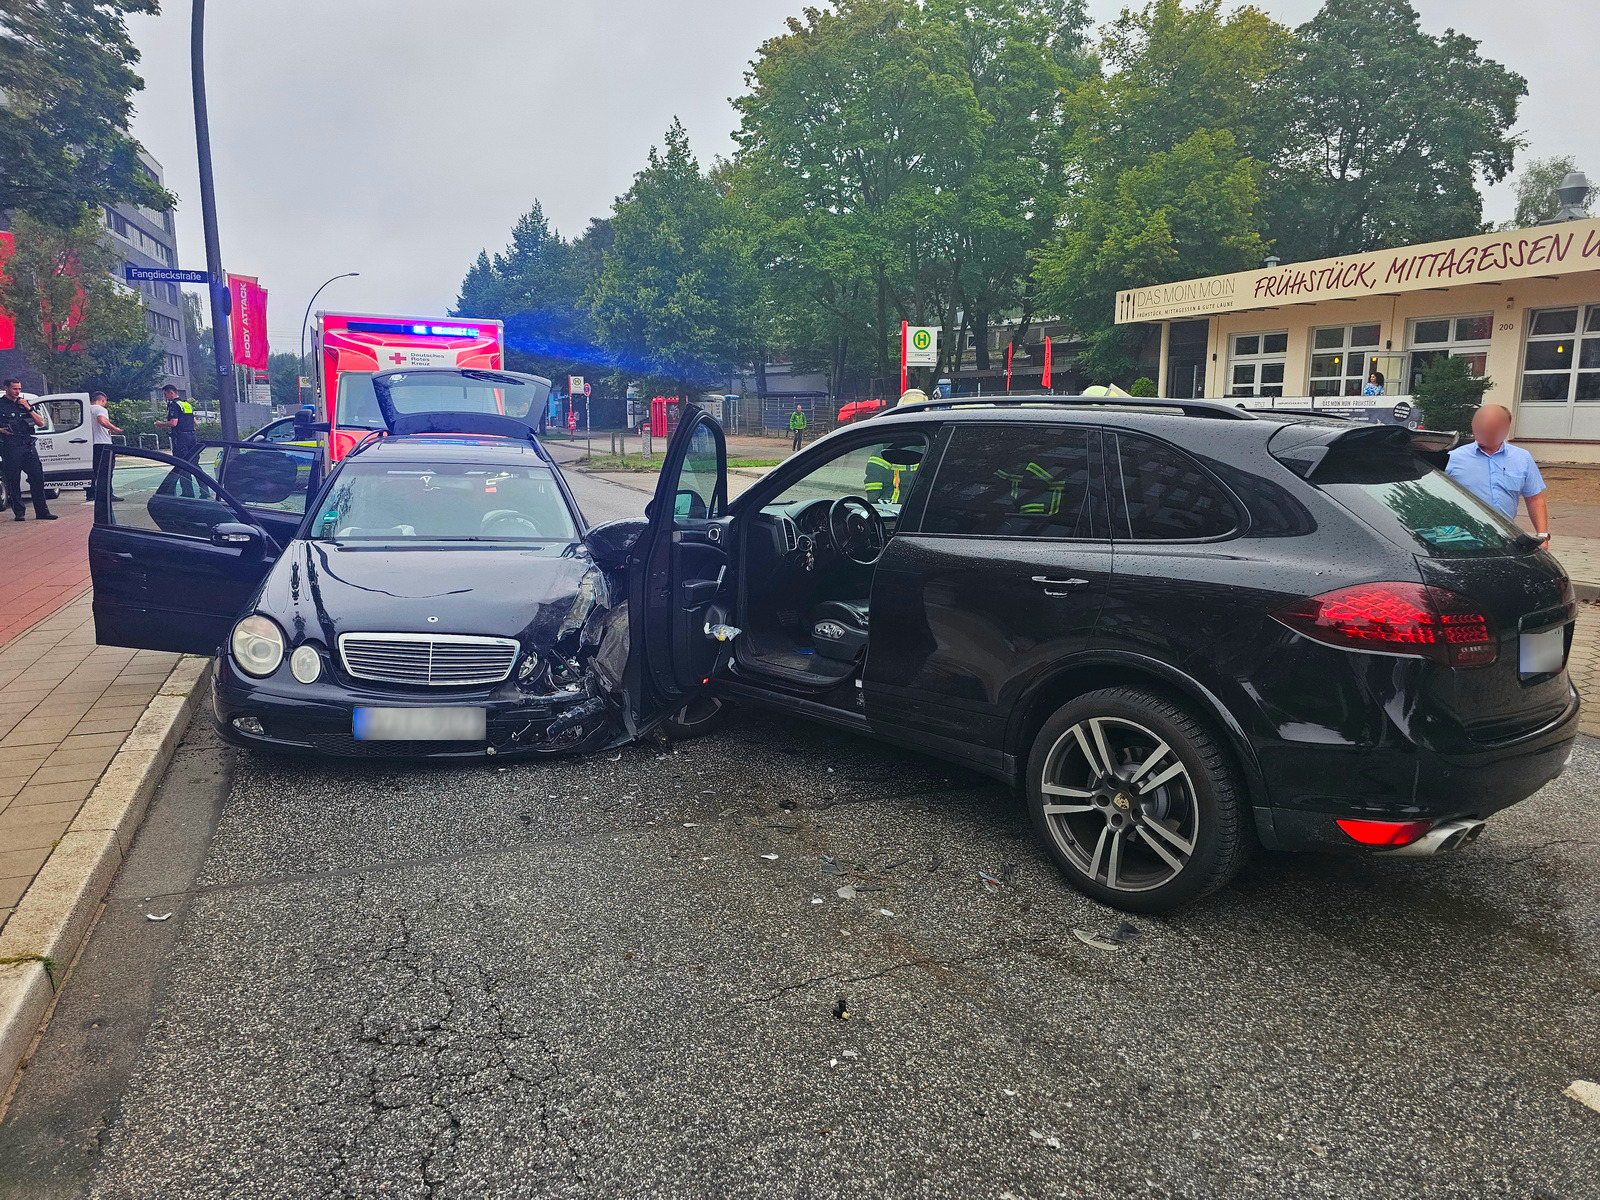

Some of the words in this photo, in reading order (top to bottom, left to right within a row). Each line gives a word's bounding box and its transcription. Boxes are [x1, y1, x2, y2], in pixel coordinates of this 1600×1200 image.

[131, 268, 202, 281] Fangdieckstraße
[1254, 261, 1378, 298] FRÜHSTÜCK,
[1384, 233, 1574, 284] MITTAGESSEN
[1137, 289, 1161, 307] DAS
[1163, 284, 1196, 303] MOIN
[1199, 278, 1236, 298] MOIN
[240, 282, 249, 326] ATTACK
[1165, 306, 1196, 315] MITTAGESSEN
[1202, 303, 1215, 311] GUTE
[1217, 301, 1234, 309] LAUNE
[1499, 323, 1514, 331] 200
[243, 327, 251, 358] BODY
[917, 334, 927, 346] H
